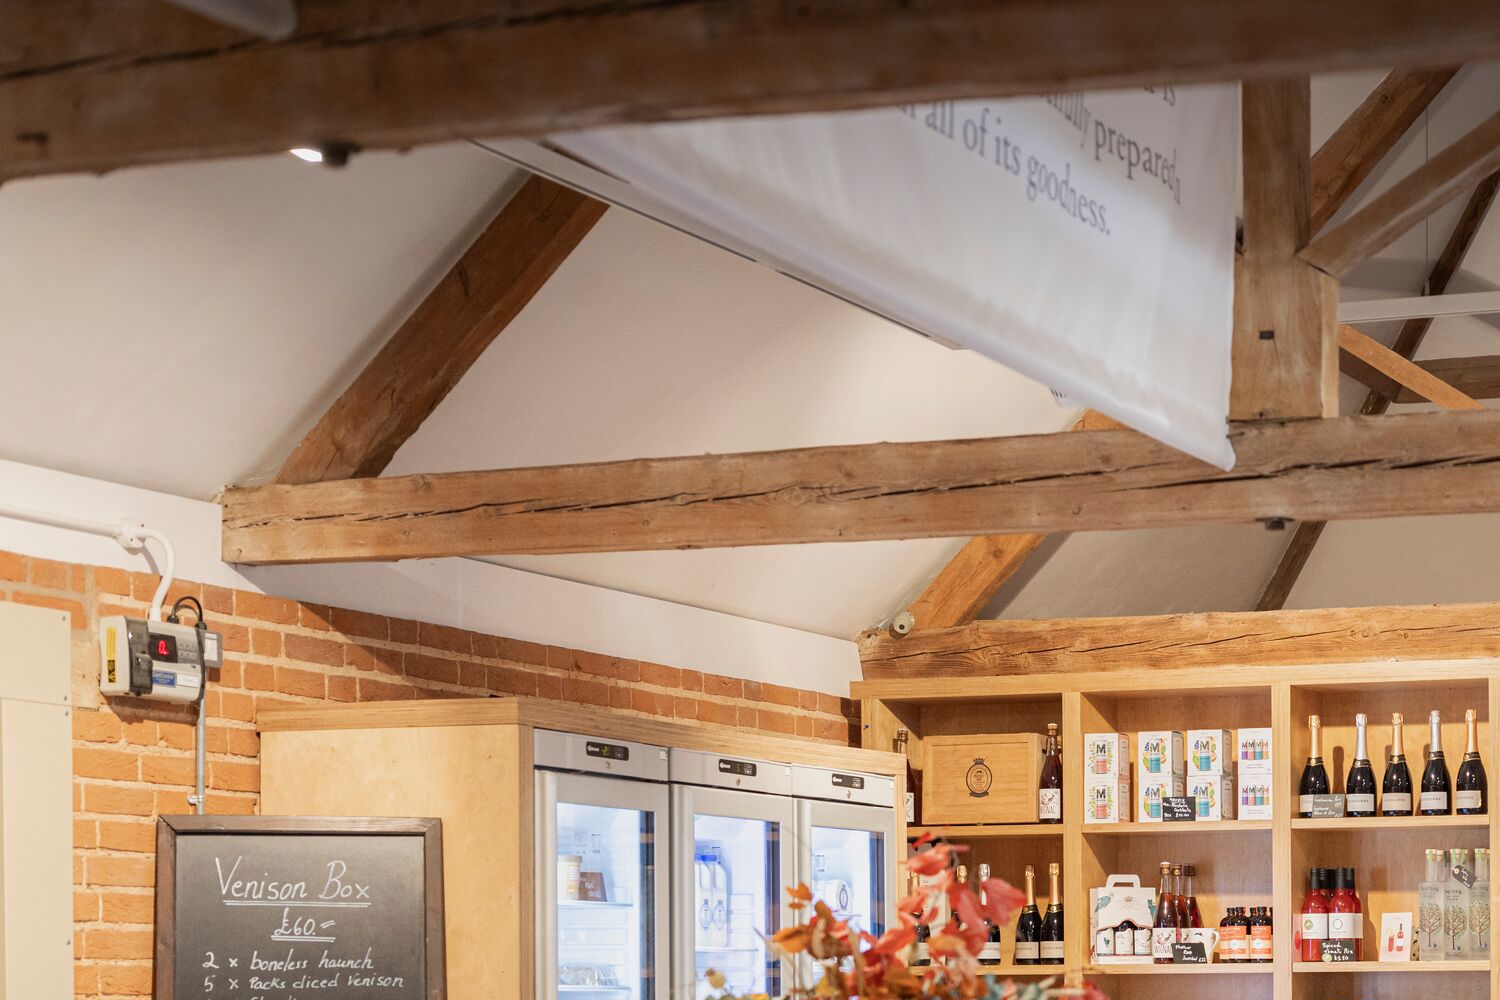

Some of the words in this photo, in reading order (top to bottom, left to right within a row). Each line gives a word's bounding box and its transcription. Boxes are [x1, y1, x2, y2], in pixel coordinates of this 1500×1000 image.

[962, 106, 990, 157] of
[994, 117, 1021, 176] its
[1026, 155, 1111, 237] goodness.
[215, 856, 307, 899] Venison
[320, 860, 370, 899] Box
[202, 952, 219, 969] 2
[250, 949, 308, 971] boneless
[318, 947, 374, 970] haunch
[203, 975, 215, 992] 5
[292, 973, 338, 989] diced
